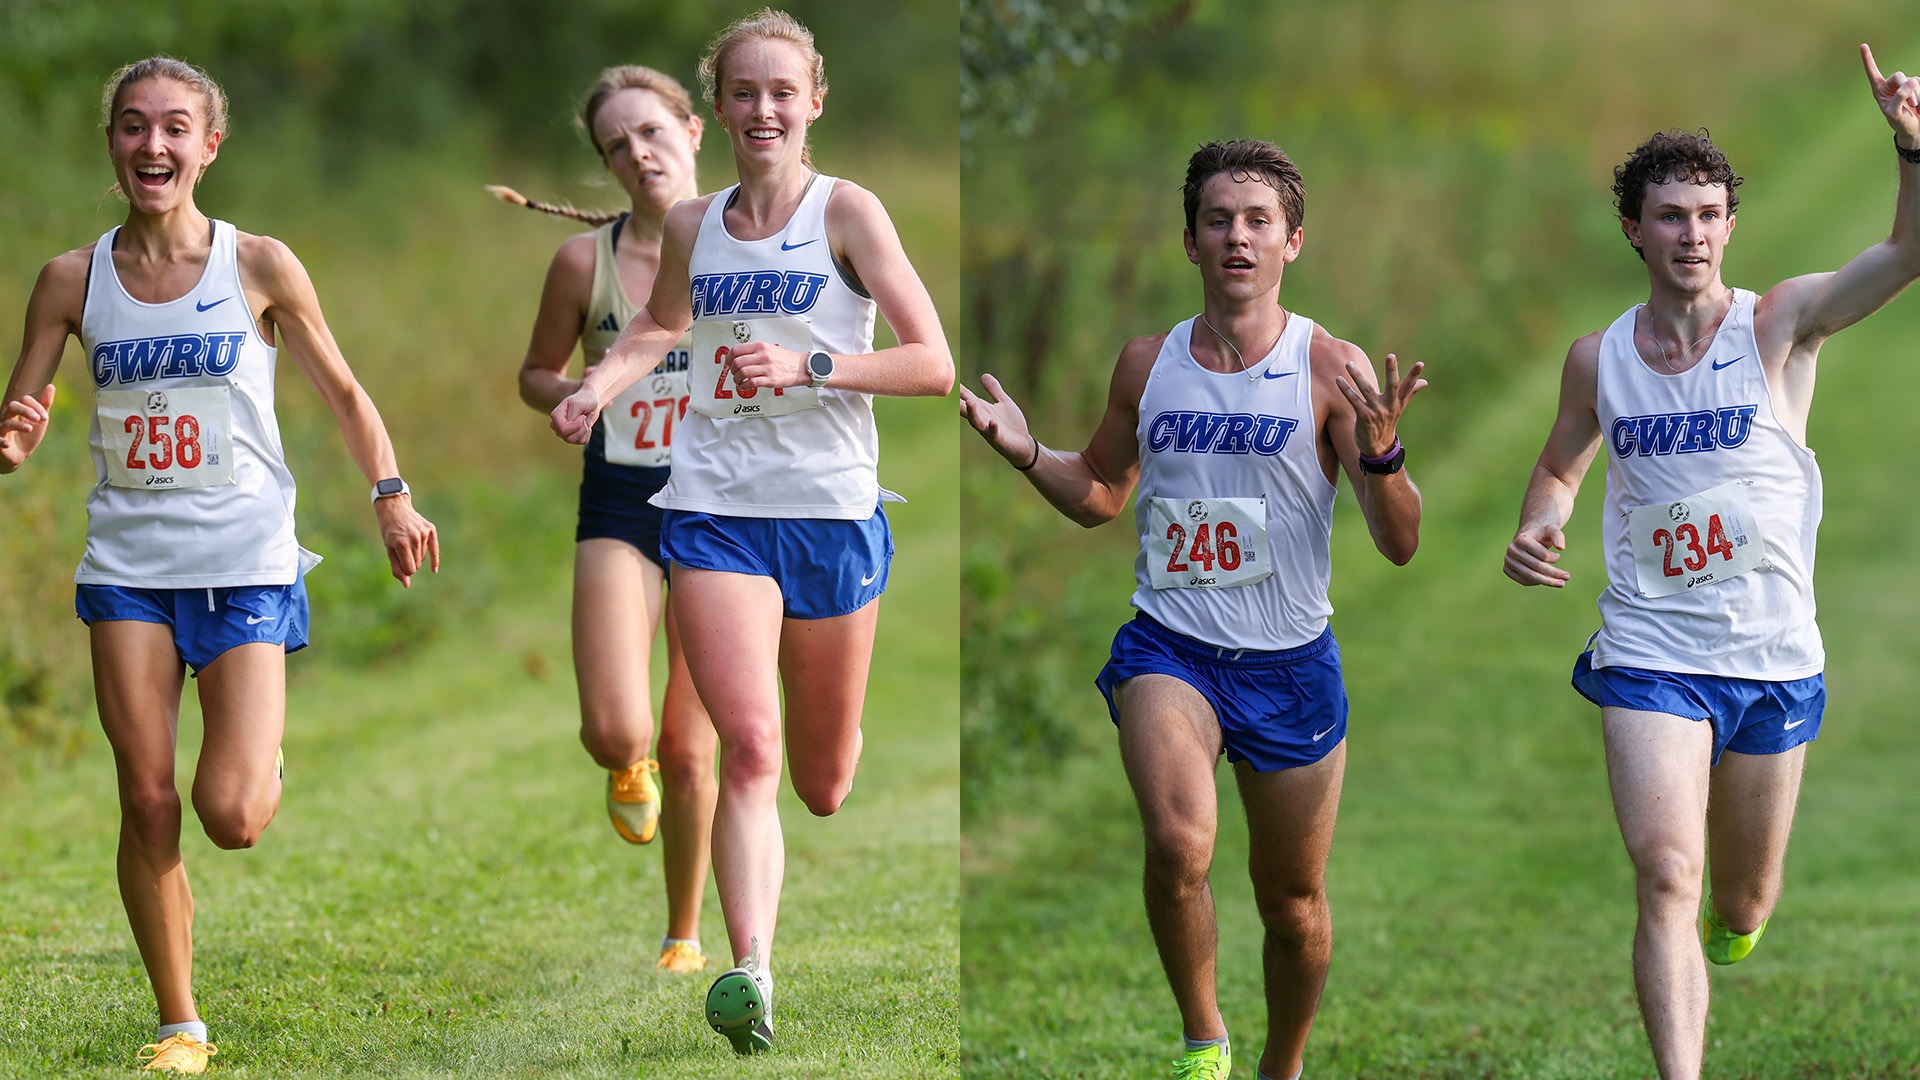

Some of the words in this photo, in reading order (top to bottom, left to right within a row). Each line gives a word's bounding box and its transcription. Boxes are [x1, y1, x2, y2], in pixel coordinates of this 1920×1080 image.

[691, 270, 829, 320] CWRU
[93, 332, 246, 387] CWRU
[124, 415, 201, 470] 258
[1148, 410, 1299, 456] CWRU
[1611, 404, 1758, 459] CWRU
[154, 476, 174, 484] asics
[1167, 521, 1241, 572] 246
[1653, 513, 1733, 577] 234
[1197, 577, 1216, 585] asics
[1695, 573, 1714, 584] asics
